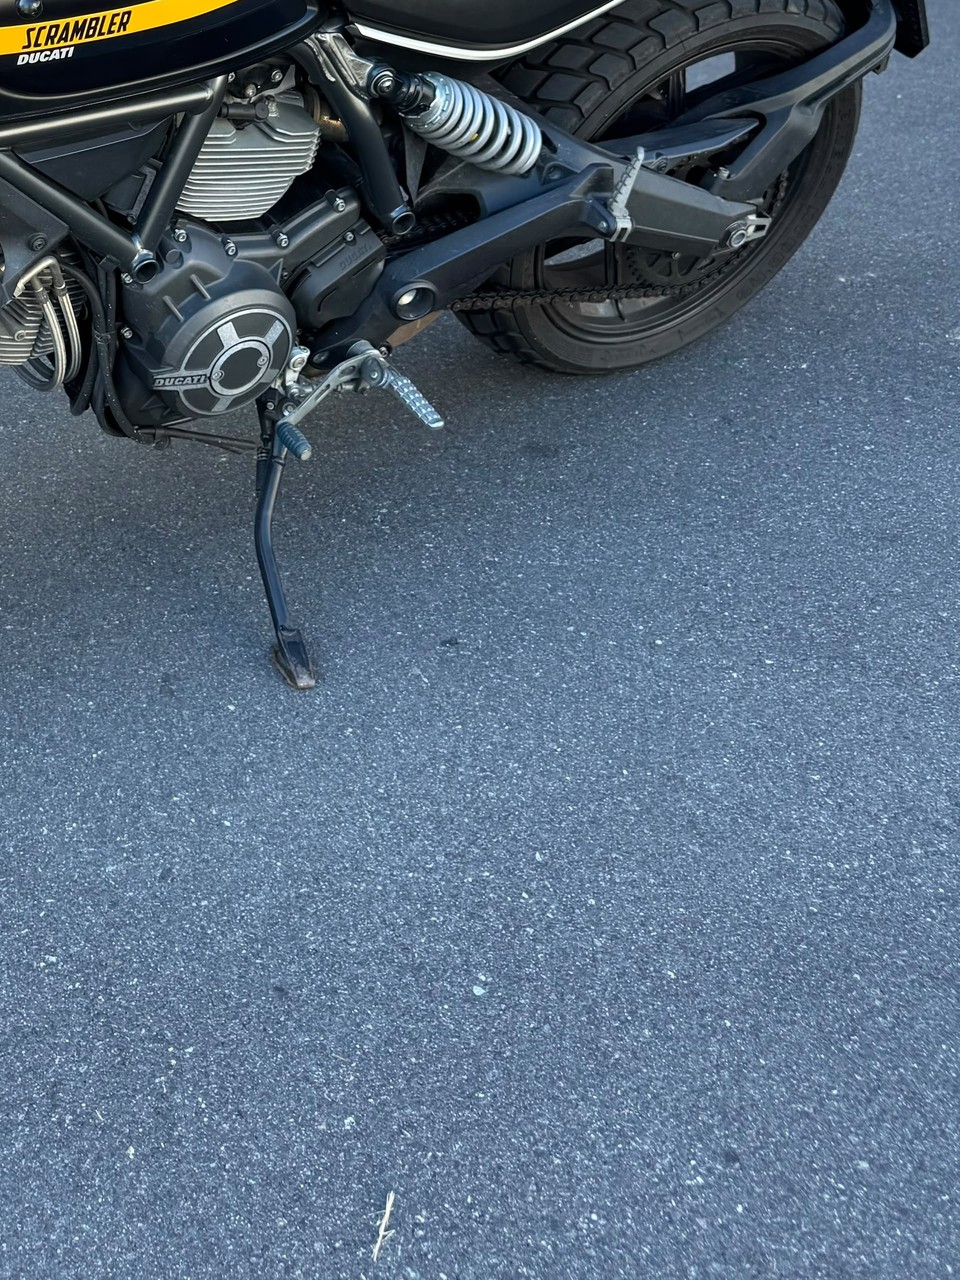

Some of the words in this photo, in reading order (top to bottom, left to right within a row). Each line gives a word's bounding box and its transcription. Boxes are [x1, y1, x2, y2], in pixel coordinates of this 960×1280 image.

[22, 10, 132, 50] SCRAMBLER
[17, 46, 75, 66] DUCATI
[153, 375, 206, 387] DUCATI
